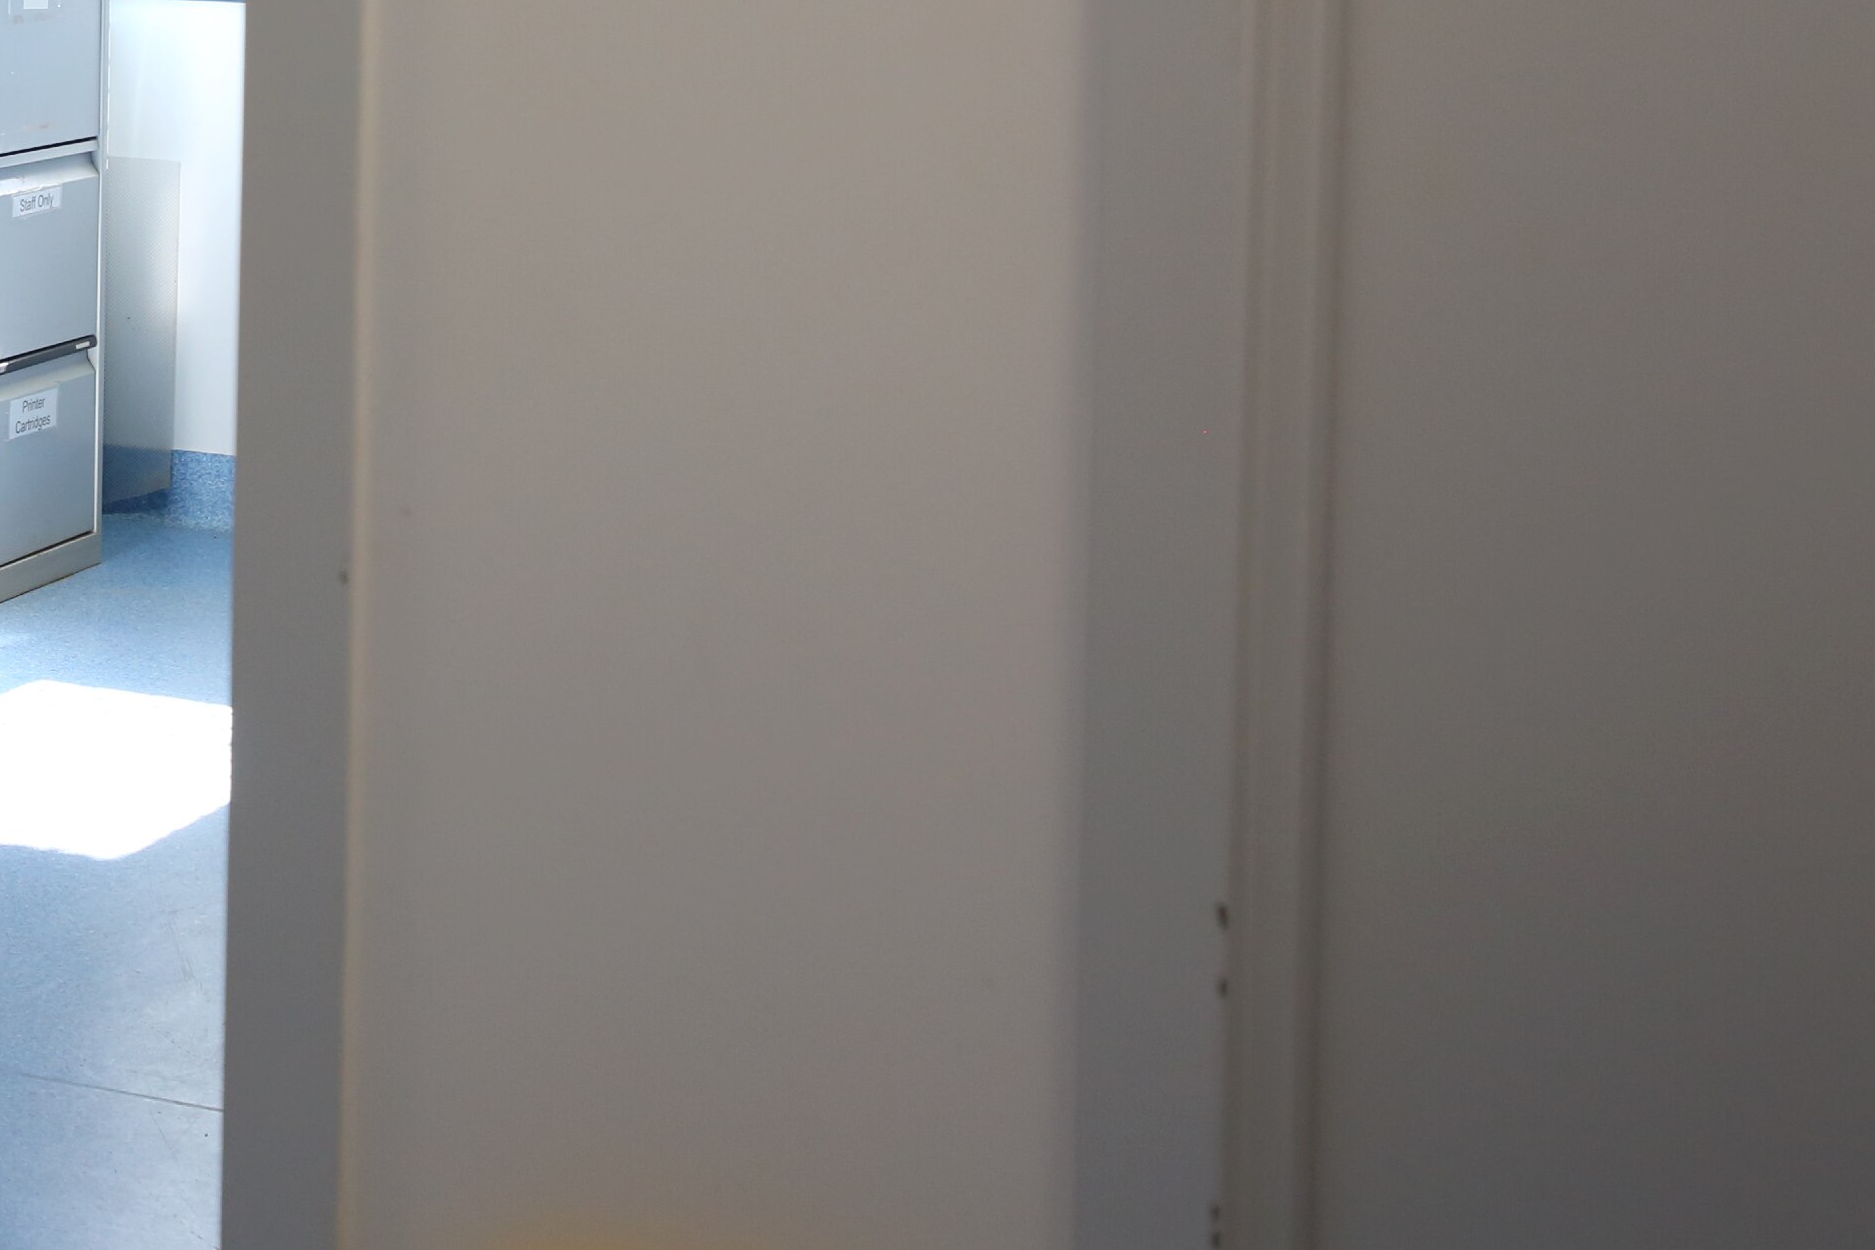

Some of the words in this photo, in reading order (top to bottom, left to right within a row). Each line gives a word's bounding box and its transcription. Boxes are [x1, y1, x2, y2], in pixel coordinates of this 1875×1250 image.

[20, 196, 36, 212] Staff
[37, 193, 54, 209] Only
[22, 398, 45, 413] Printer
[15, 415, 51, 434] Cartridges
